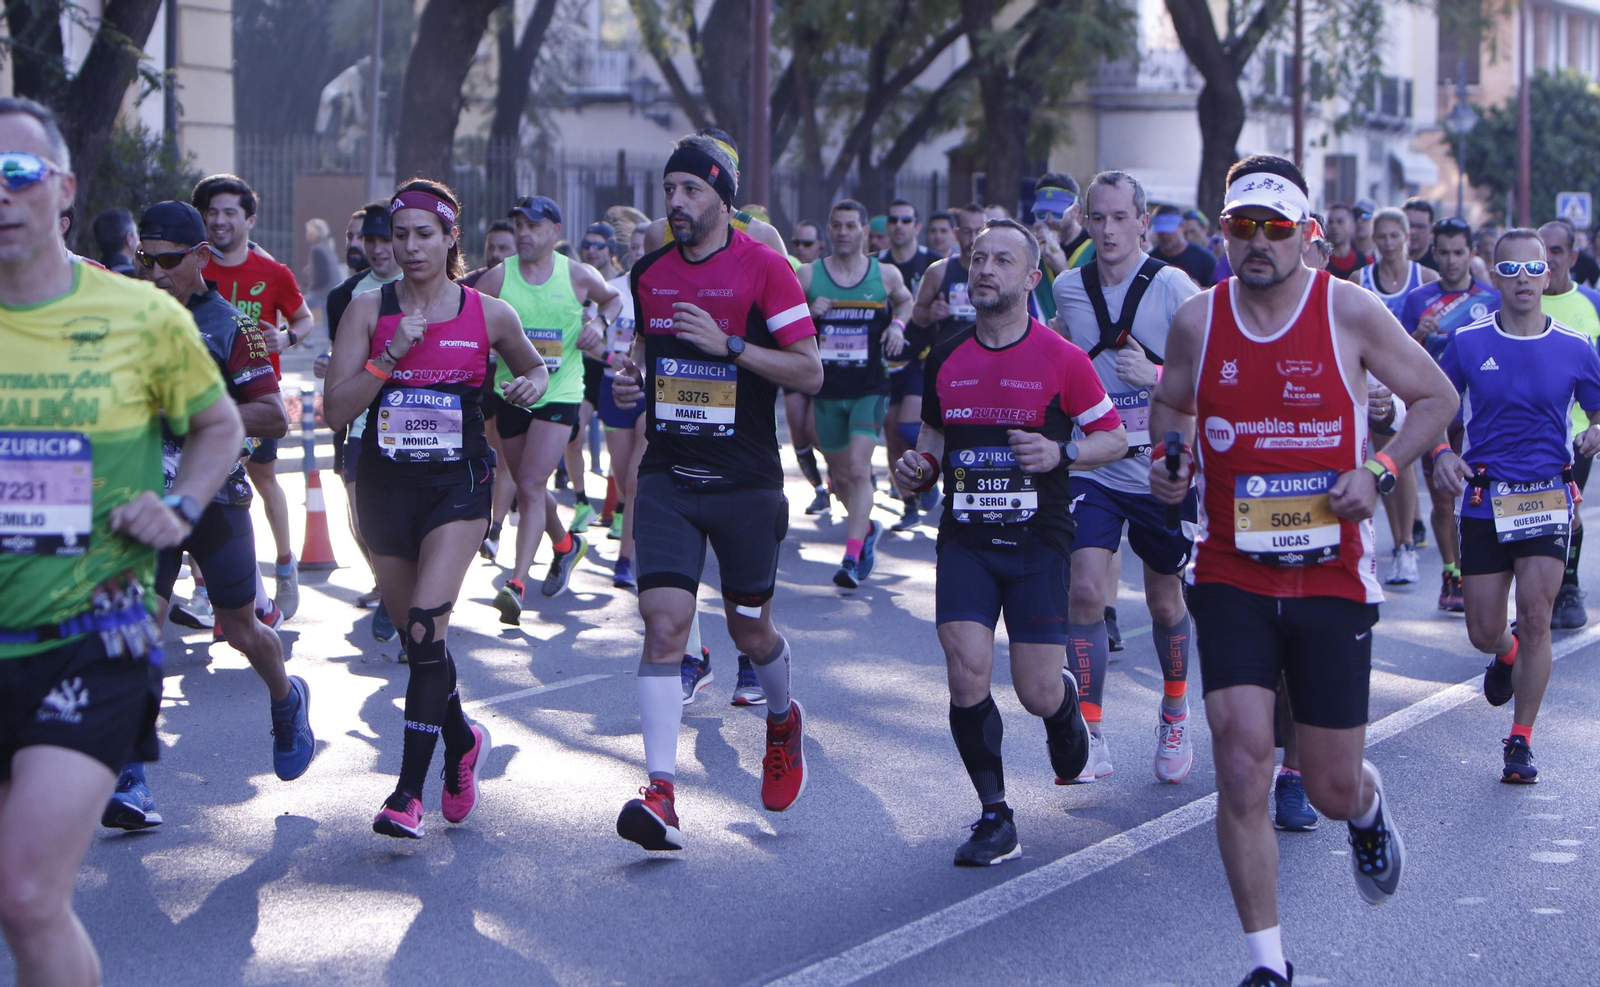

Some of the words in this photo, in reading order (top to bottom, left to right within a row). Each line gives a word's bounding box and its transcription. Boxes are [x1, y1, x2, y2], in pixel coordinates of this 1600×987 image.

[526, 330, 557, 338] ZURICH
[440, 340, 479, 348] SPORTRAVEL
[680, 364, 726, 376] ZURICH
[678, 390, 710, 404] 3375
[1283, 389, 1320, 398] ALECOM
[676, 408, 708, 420] MANEL
[946, 408, 1036, 420] PRORUNNERS
[405, 420, 438, 431] 8295
[1235, 417, 1296, 434] muebles
[1299, 416, 1342, 436] miguel
[1207, 426, 1230, 440] mm
[402, 436, 438, 446] MONICA
[1270, 438, 1304, 447] medina
[1305, 436, 1336, 446] sidonia
[978, 478, 1010, 490] 3187
[1270, 476, 1327, 492] ZURICH
[1514, 480, 1554, 492] ZURICH
[980, 498, 1007, 506] SERGI
[1517, 500, 1544, 512] 4201
[1271, 512, 1312, 527] 5064
[1514, 514, 1552, 528] QUEBRAN
[1272, 535, 1310, 548] LUCAS
[1166, 634, 1187, 677] kalenji
[1070, 638, 1094, 696] kalenji
